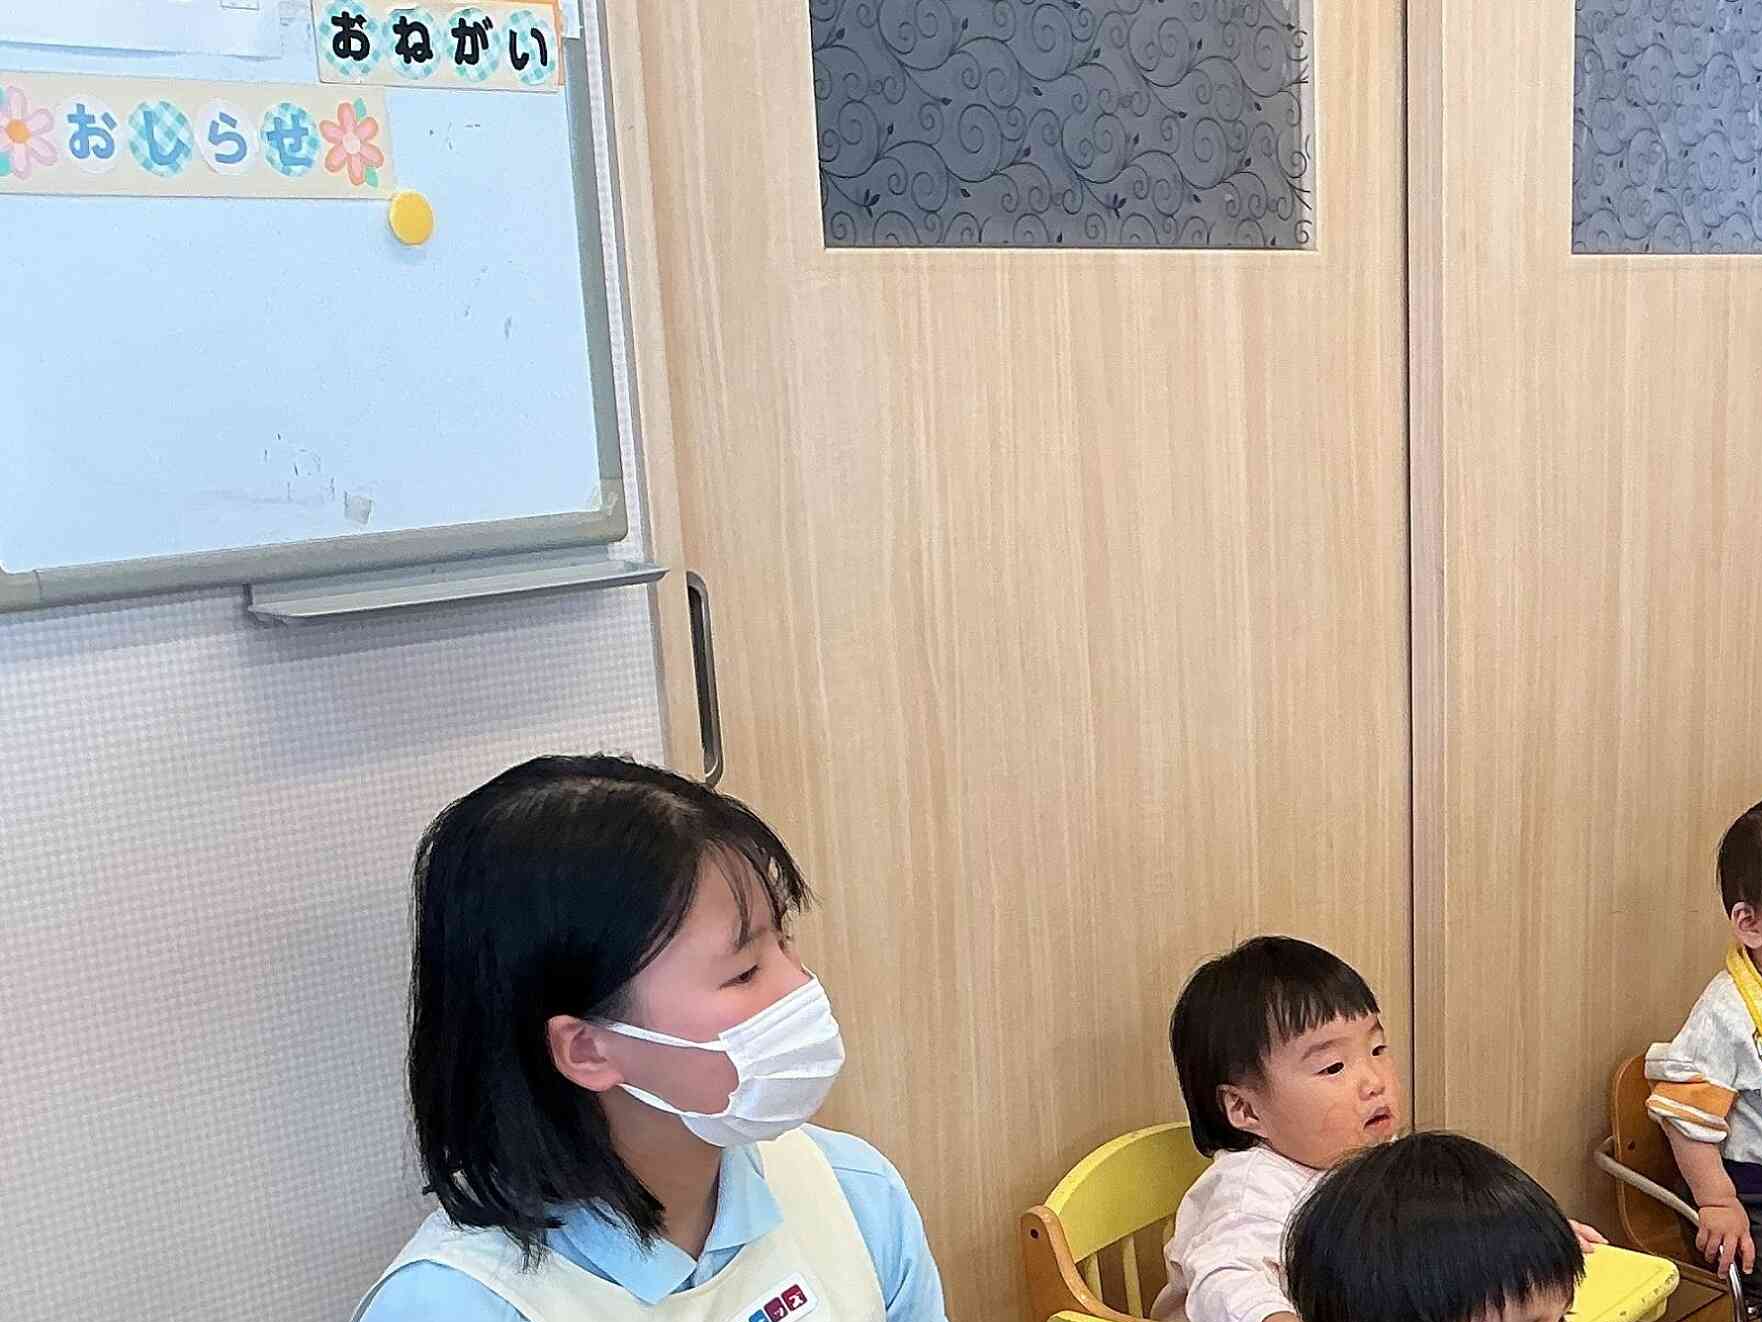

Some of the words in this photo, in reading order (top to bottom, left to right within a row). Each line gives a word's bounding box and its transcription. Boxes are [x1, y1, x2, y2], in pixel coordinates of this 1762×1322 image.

[331, 10, 548, 71] おねがい
[66, 101, 316, 167] おしらせ
